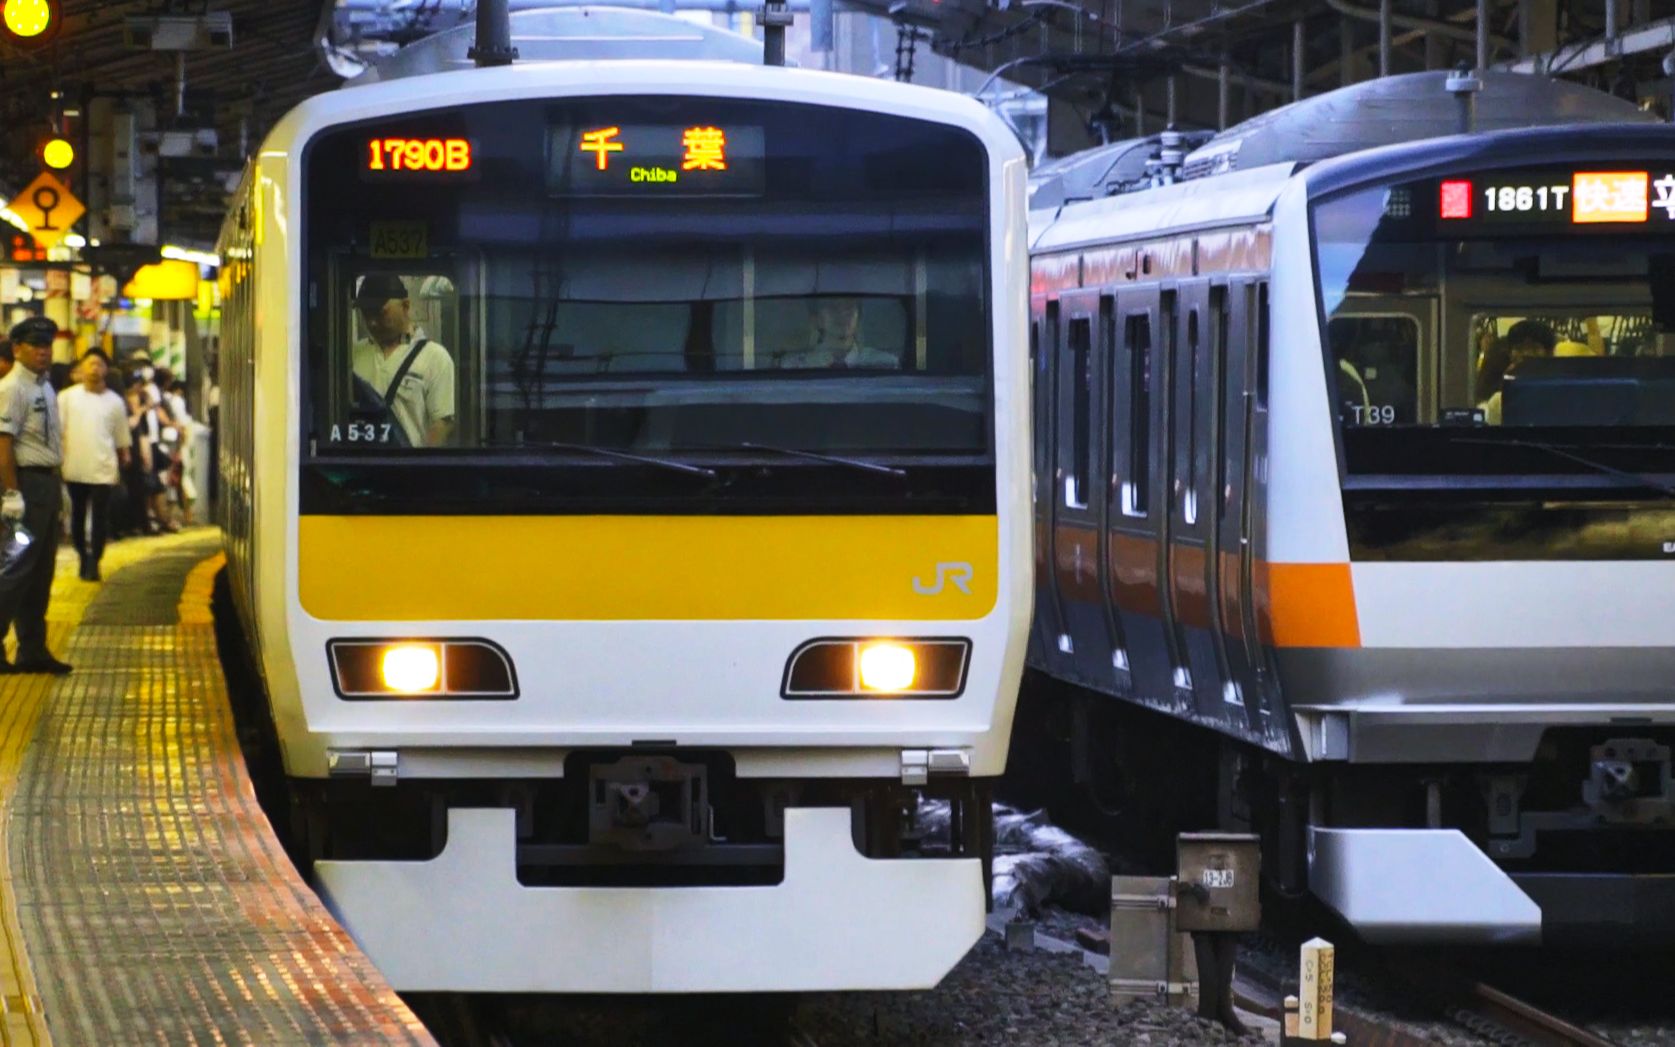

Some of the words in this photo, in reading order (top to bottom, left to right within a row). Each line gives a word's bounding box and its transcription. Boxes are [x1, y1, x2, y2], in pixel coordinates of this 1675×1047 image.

[368, 138, 472, 171] 1790B
[580, 127, 726, 170] 千葉
[630, 167, 678, 183] Chiba
[1484, 185, 1570, 211] 1861T
[374, 229, 424, 254] A537
[1351, 405, 1395, 425] T39
[912, 561, 974, 595] JR
